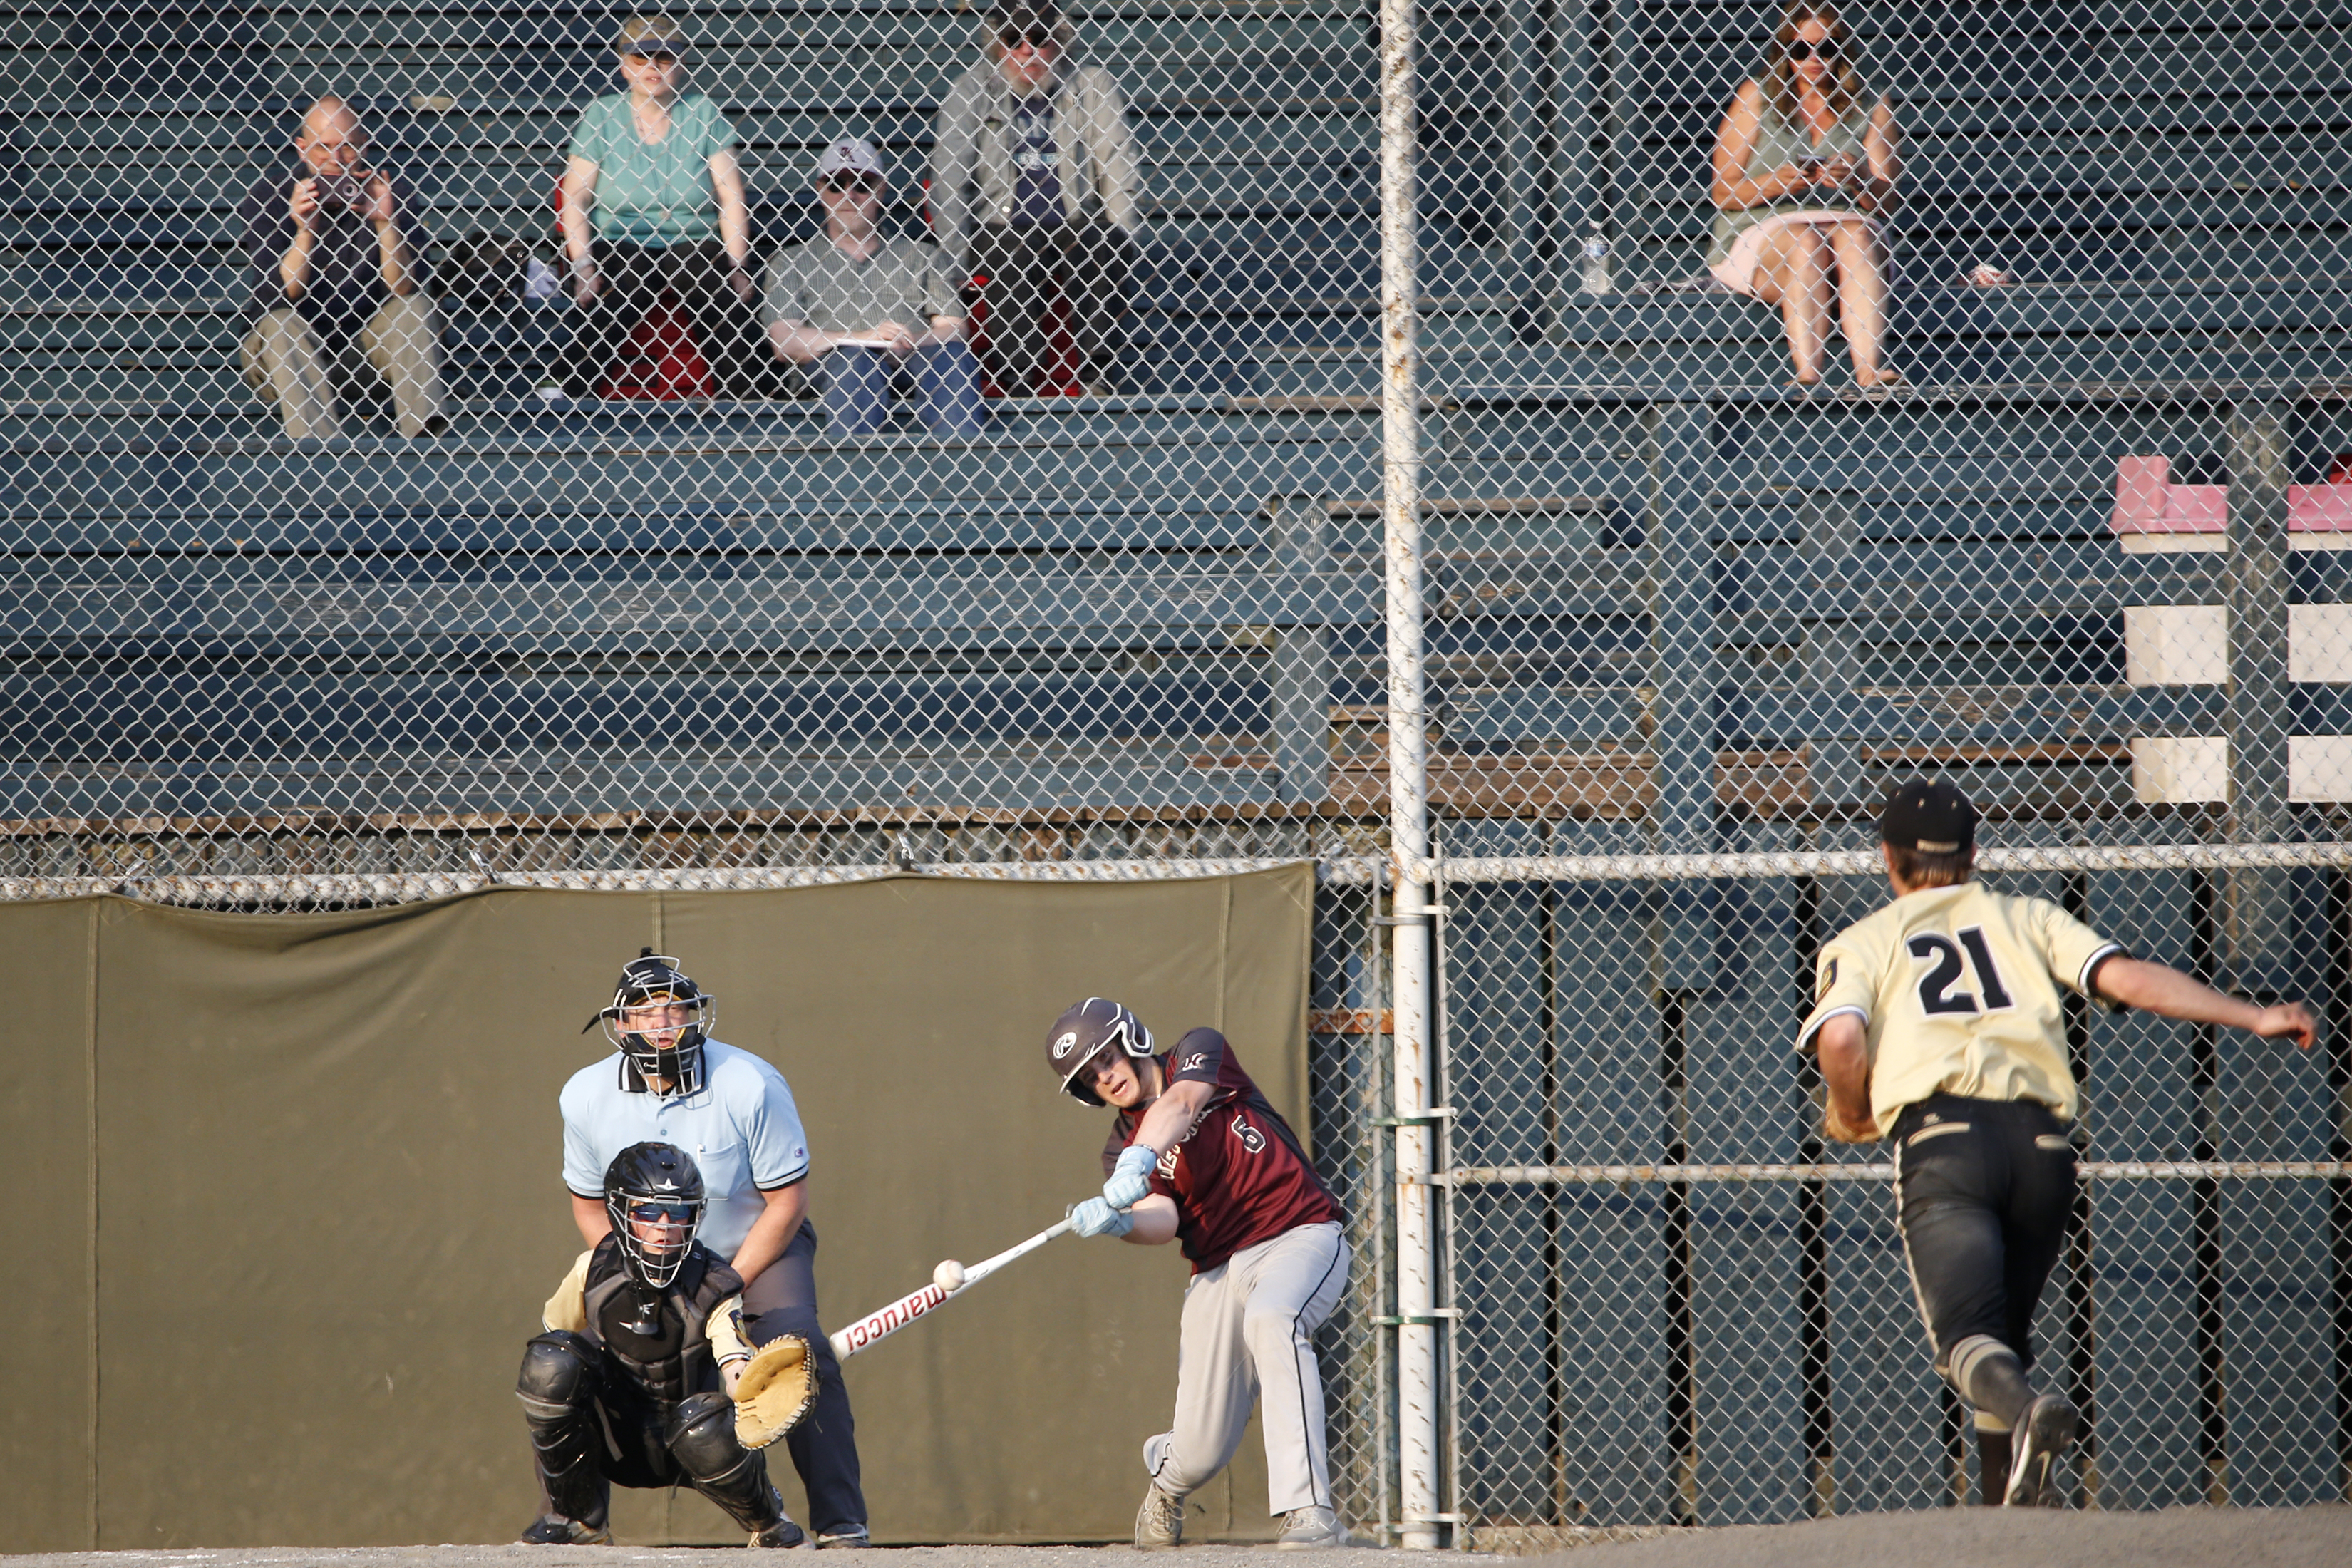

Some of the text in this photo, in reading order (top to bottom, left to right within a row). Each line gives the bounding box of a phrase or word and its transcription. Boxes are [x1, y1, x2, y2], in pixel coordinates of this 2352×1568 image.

[1905, 924, 2014, 1018] 21
[1230, 1114, 1267, 1155] 6
[846, 1286, 947, 1353] marucci
